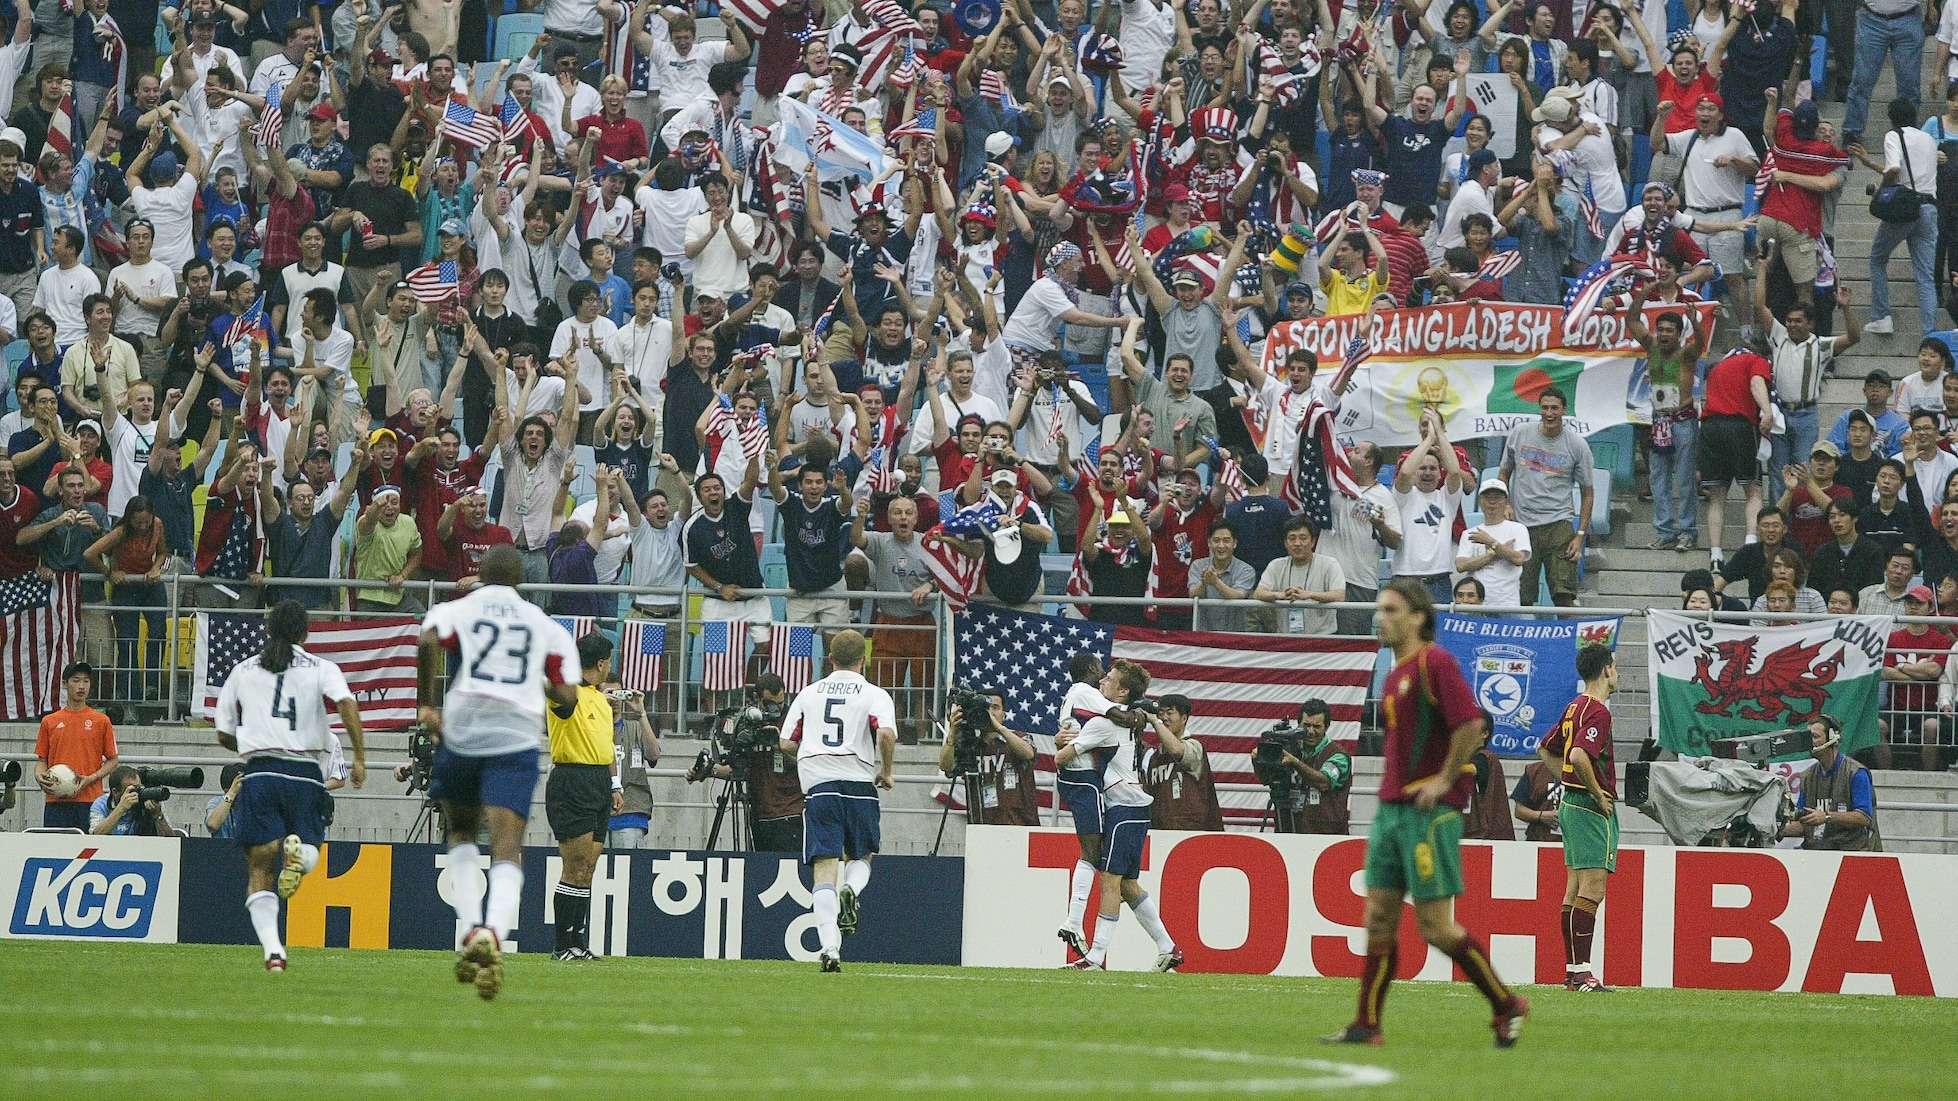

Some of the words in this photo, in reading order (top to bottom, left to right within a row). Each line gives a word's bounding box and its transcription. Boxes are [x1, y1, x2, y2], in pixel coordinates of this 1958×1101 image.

[1403, 135, 1432, 151] USA
[1288, 317, 1360, 358] SOON
[1369, 306, 1552, 354] BANGLADESH
[1562, 311, 1648, 350] ORL
[1474, 415, 1591, 433] BANGESH
[709, 536, 737, 560] USA
[799, 527, 826, 545] USA
[891, 565, 919, 577] USA
[483, 602, 520, 618] POPE
[1443, 617, 1478, 634] THE
[1480, 622, 1574, 639] BLUEBIRDS
[470, 619, 532, 685] 23
[1655, 621, 1714, 664] REVS
[817, 681, 863, 695] O'BRIEN
[272, 674, 297, 731] 4
[821, 698, 846, 747] 5
[1491, 733, 1518, 749] City
[1522, 734, 1541, 749] Cl
[1562, 719, 1574, 773] 2
[1151, 762, 1175, 786] RTV
[25, 848, 147, 930] KCC
[1028, 831, 1936, 998] TOSHIBA
